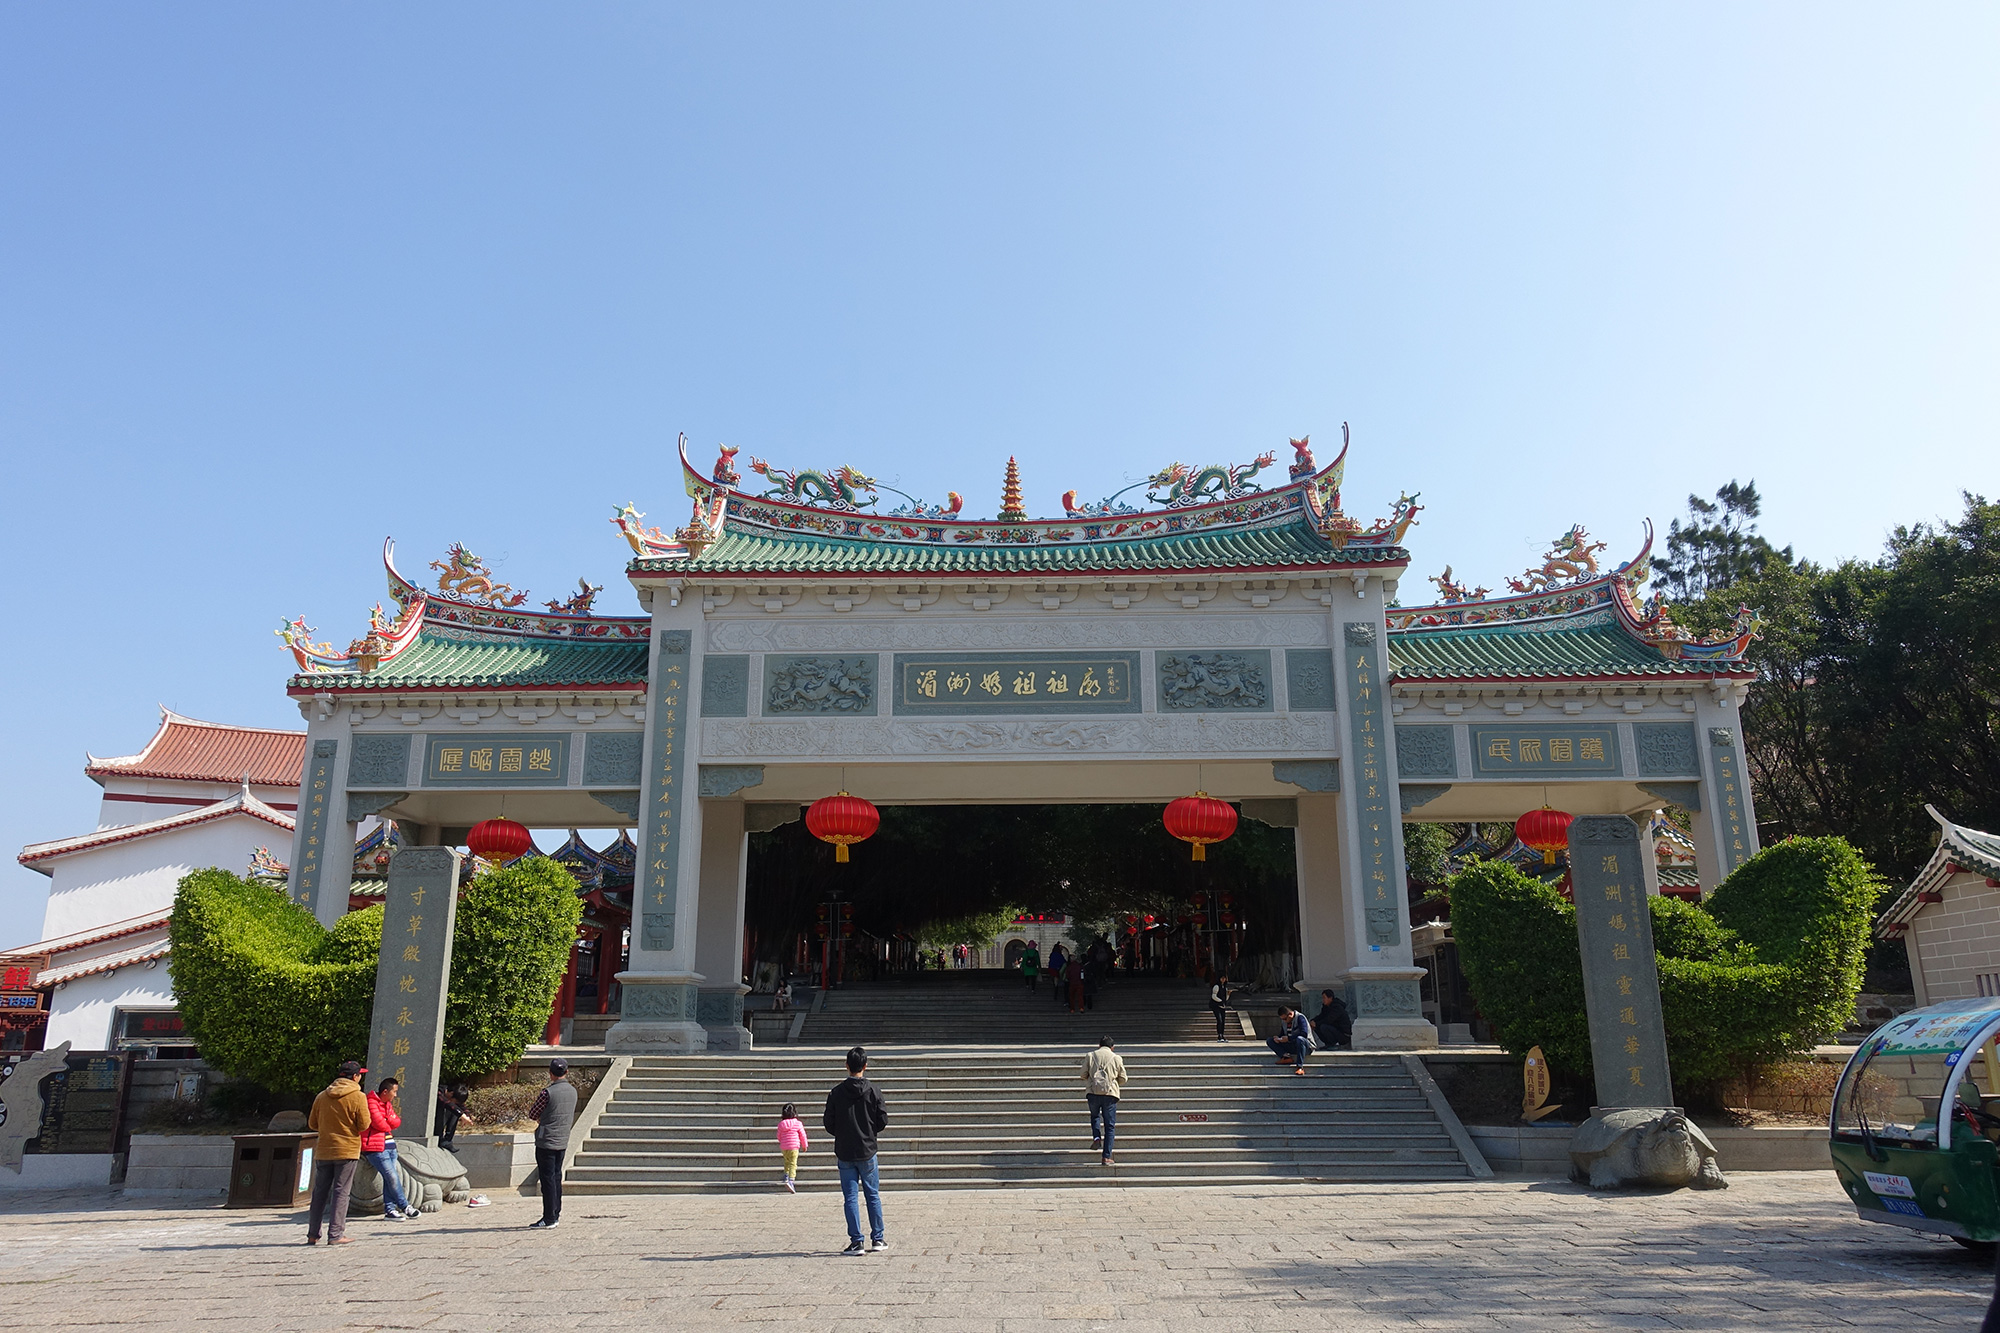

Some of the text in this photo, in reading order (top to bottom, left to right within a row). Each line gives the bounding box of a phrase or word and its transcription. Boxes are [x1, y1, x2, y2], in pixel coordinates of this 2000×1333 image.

[1, 966, 31, 991] 鲜
[1601, 854, 1645, 1088] 湄洲媽祖靈通華夏
[1948, 1053, 1960, 1063] 16
